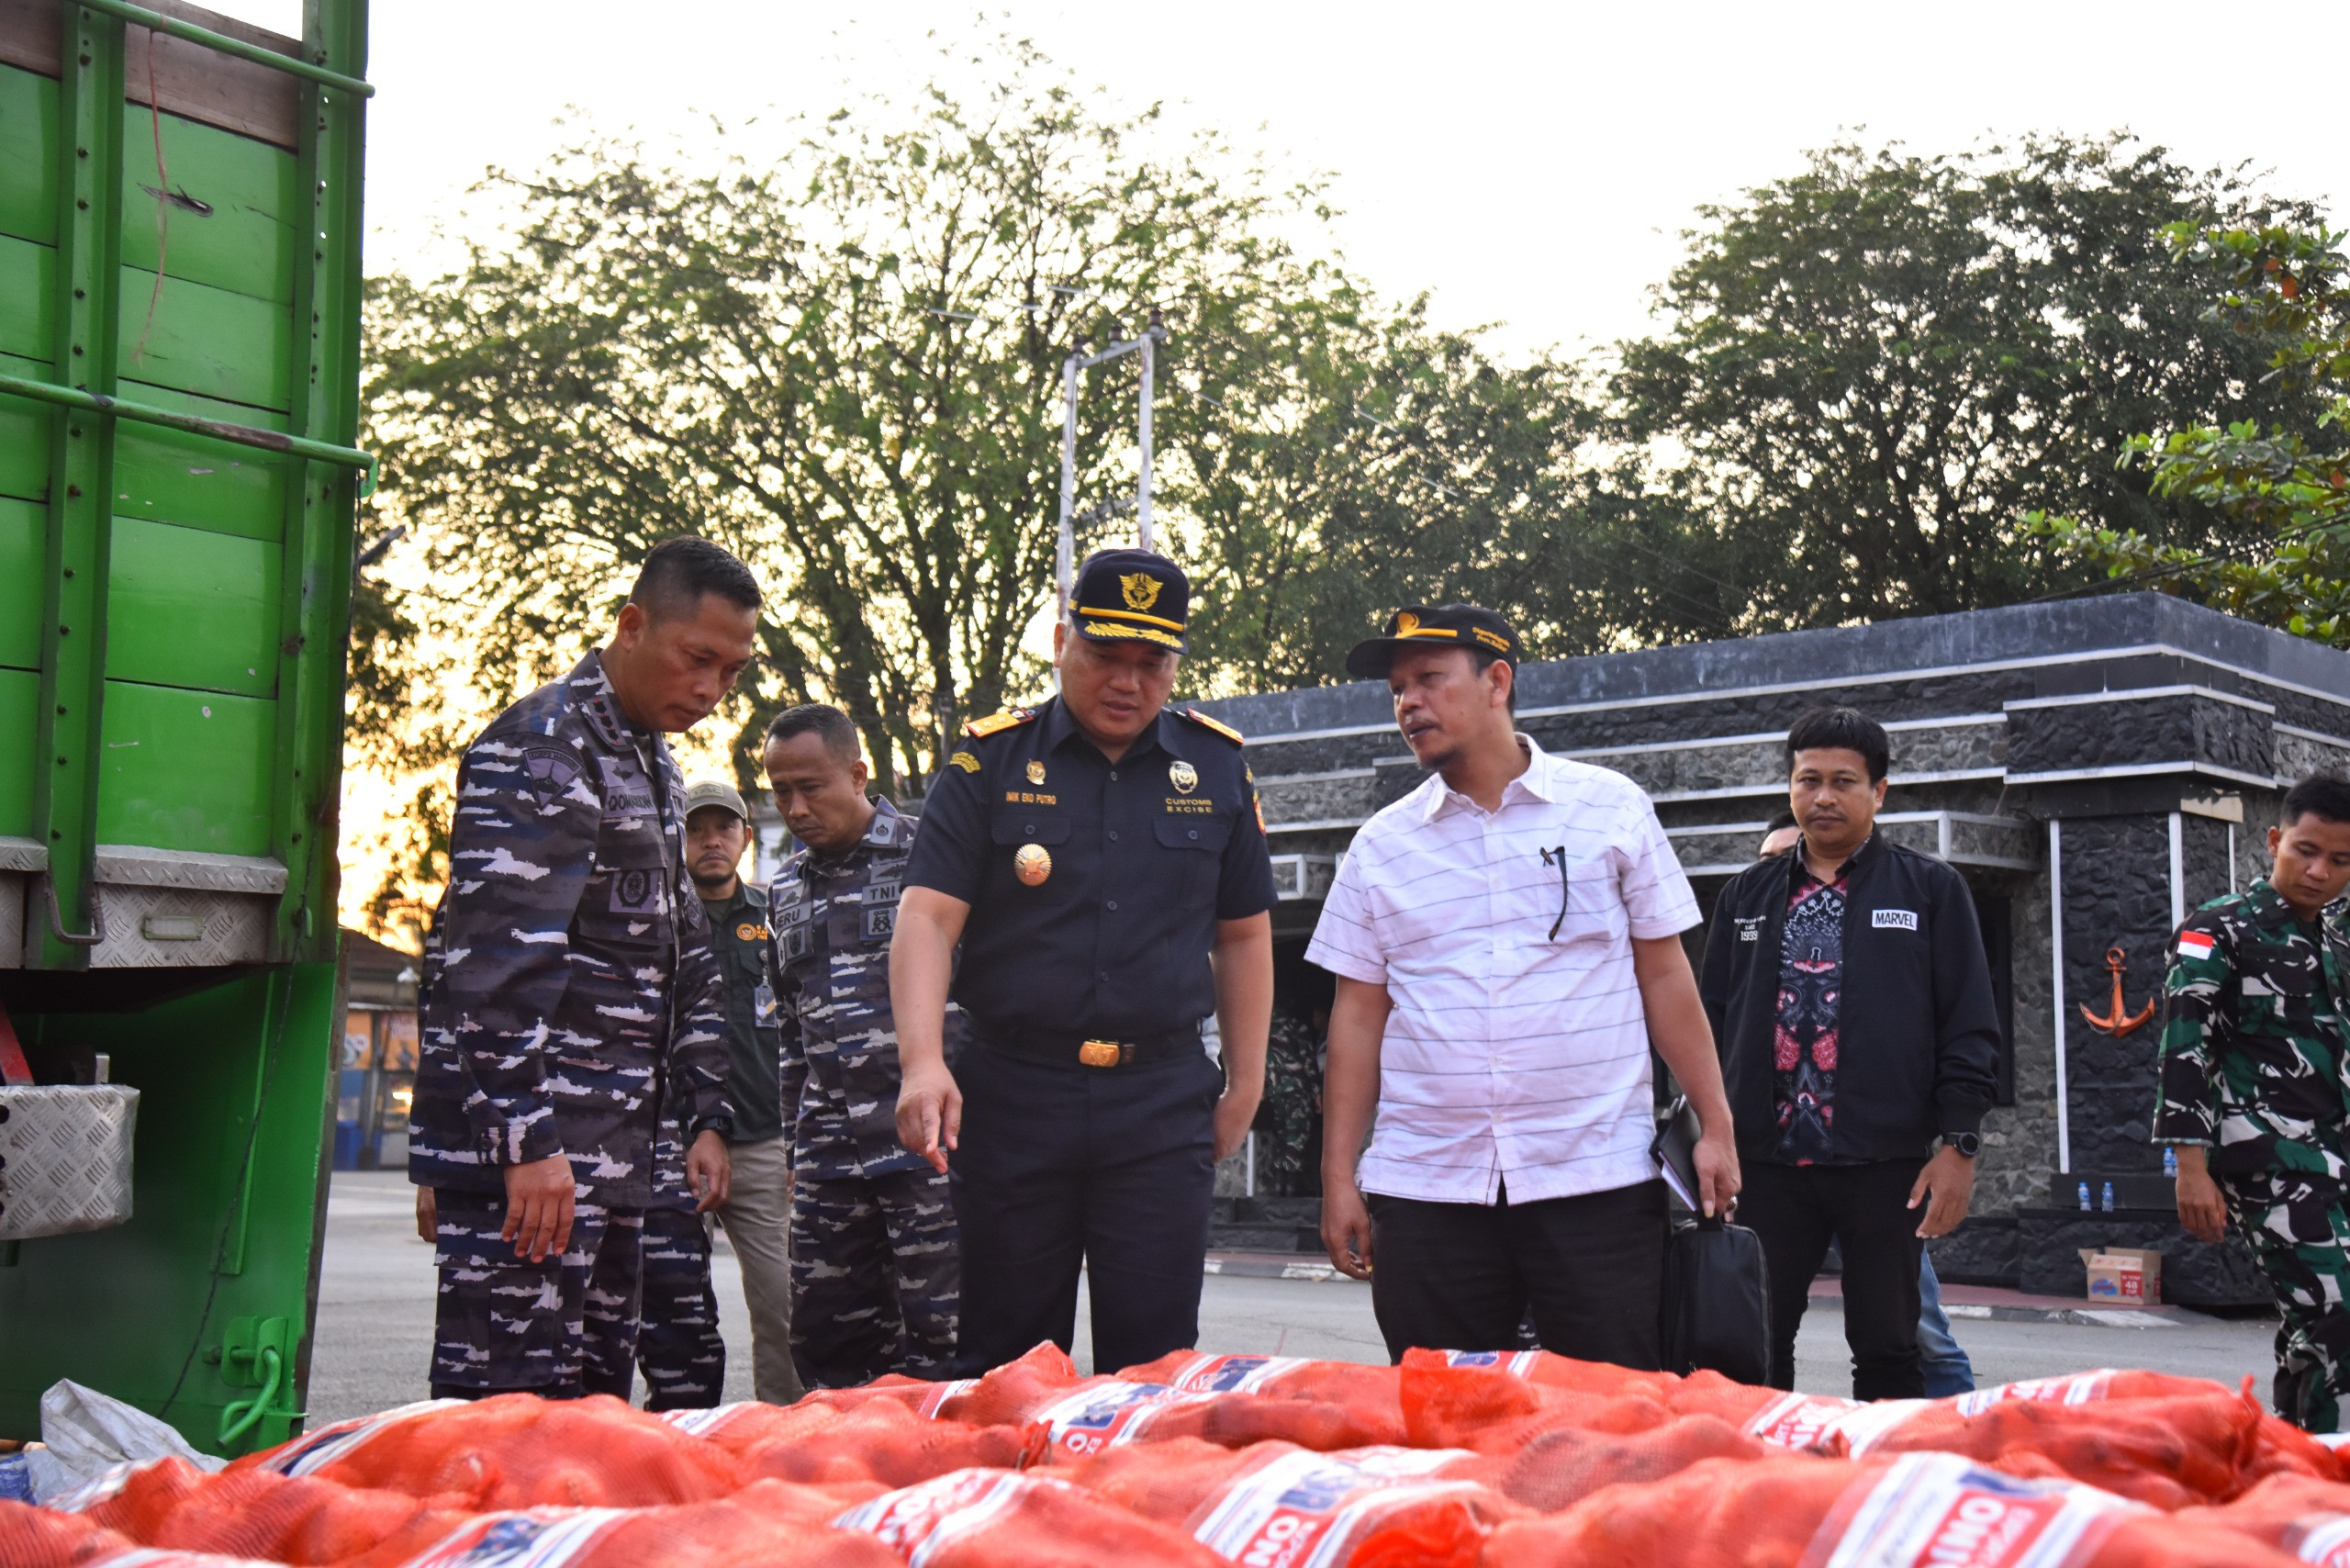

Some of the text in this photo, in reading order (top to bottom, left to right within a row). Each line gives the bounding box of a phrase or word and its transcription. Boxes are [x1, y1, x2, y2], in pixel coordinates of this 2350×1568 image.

[1167, 805, 1212, 813] EXCISE
[870, 885, 895, 900] TNI
[1875, 912, 1914, 927] MARVEL
[1740, 930, 1757, 941] 1939
